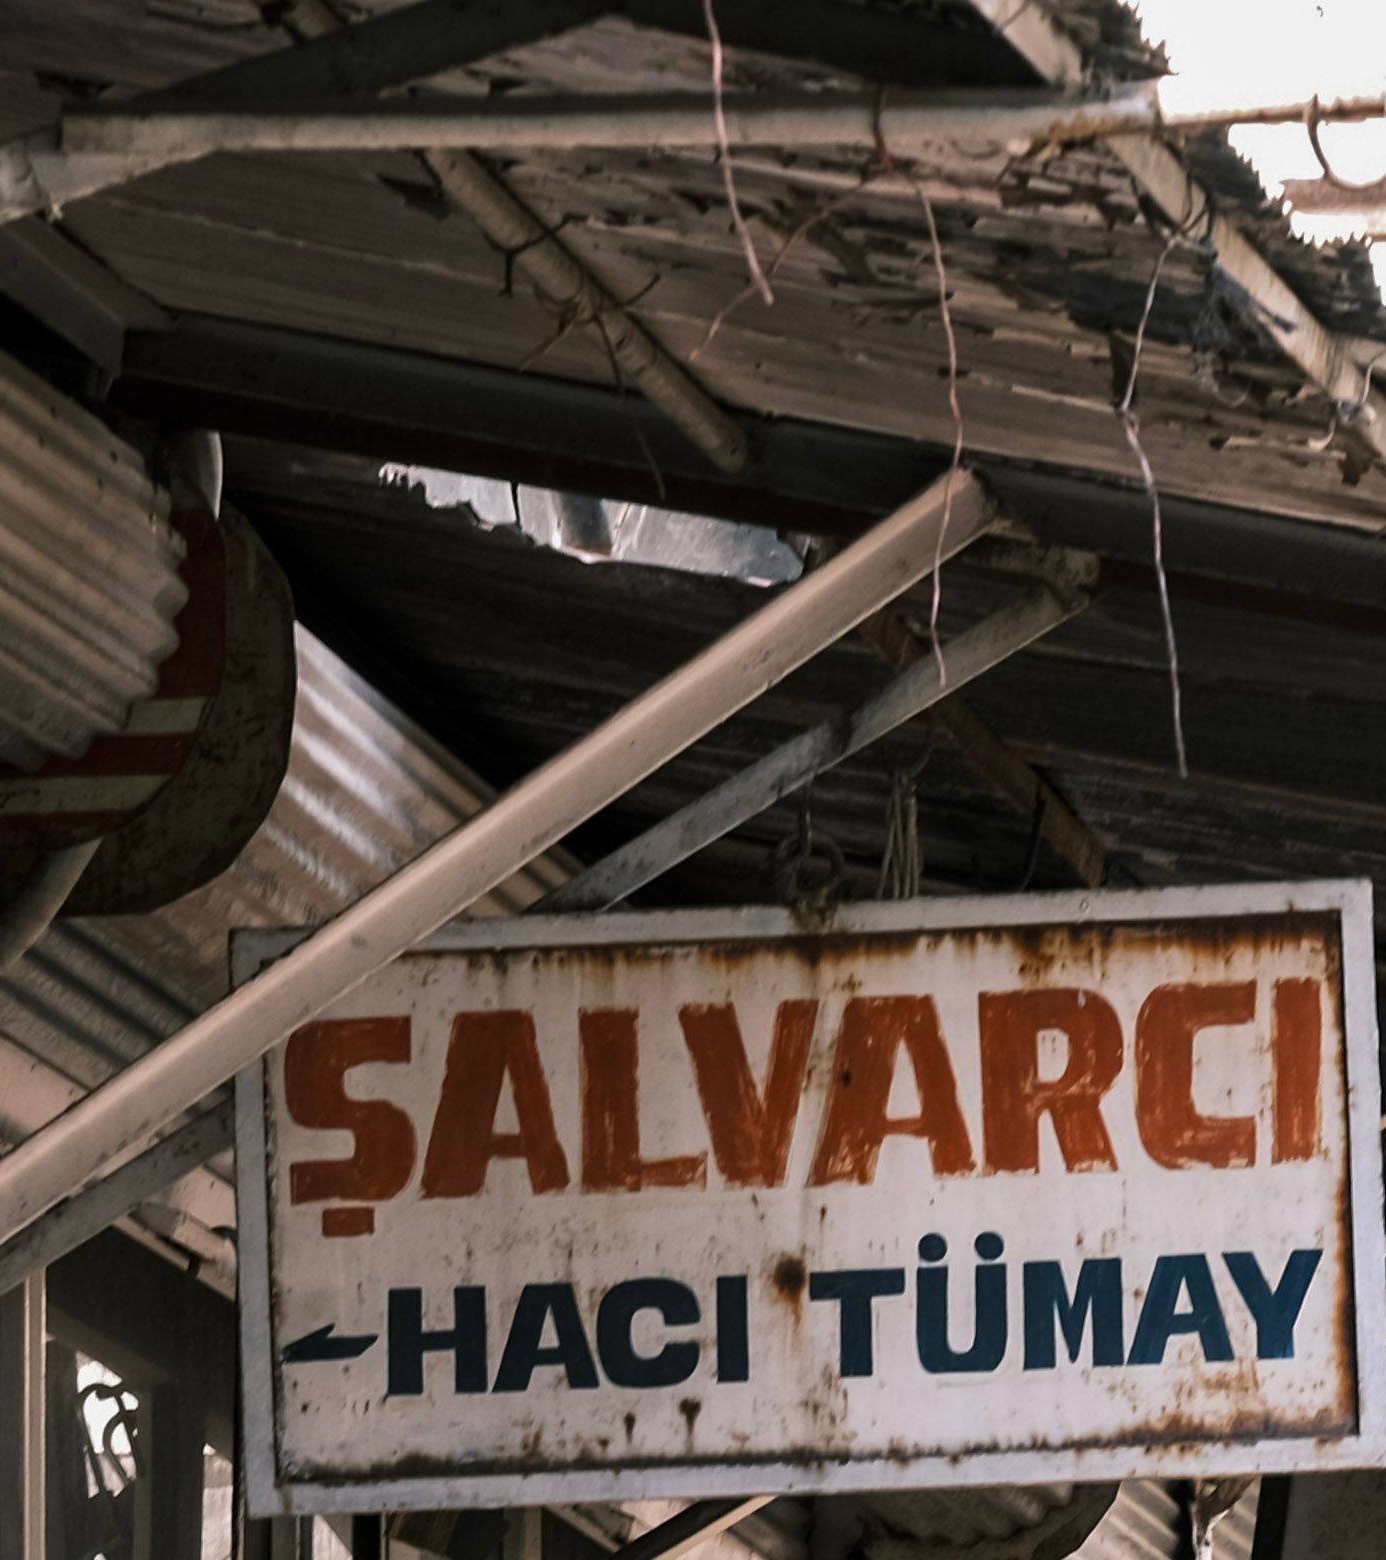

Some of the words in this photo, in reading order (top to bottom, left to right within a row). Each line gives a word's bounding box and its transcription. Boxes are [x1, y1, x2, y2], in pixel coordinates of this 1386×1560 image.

[283, 977, 1323, 1237] ŞALVARCI
[386, 1274, 750, 1395] HACI
[809, 1231, 1323, 1378] TÜMAY
